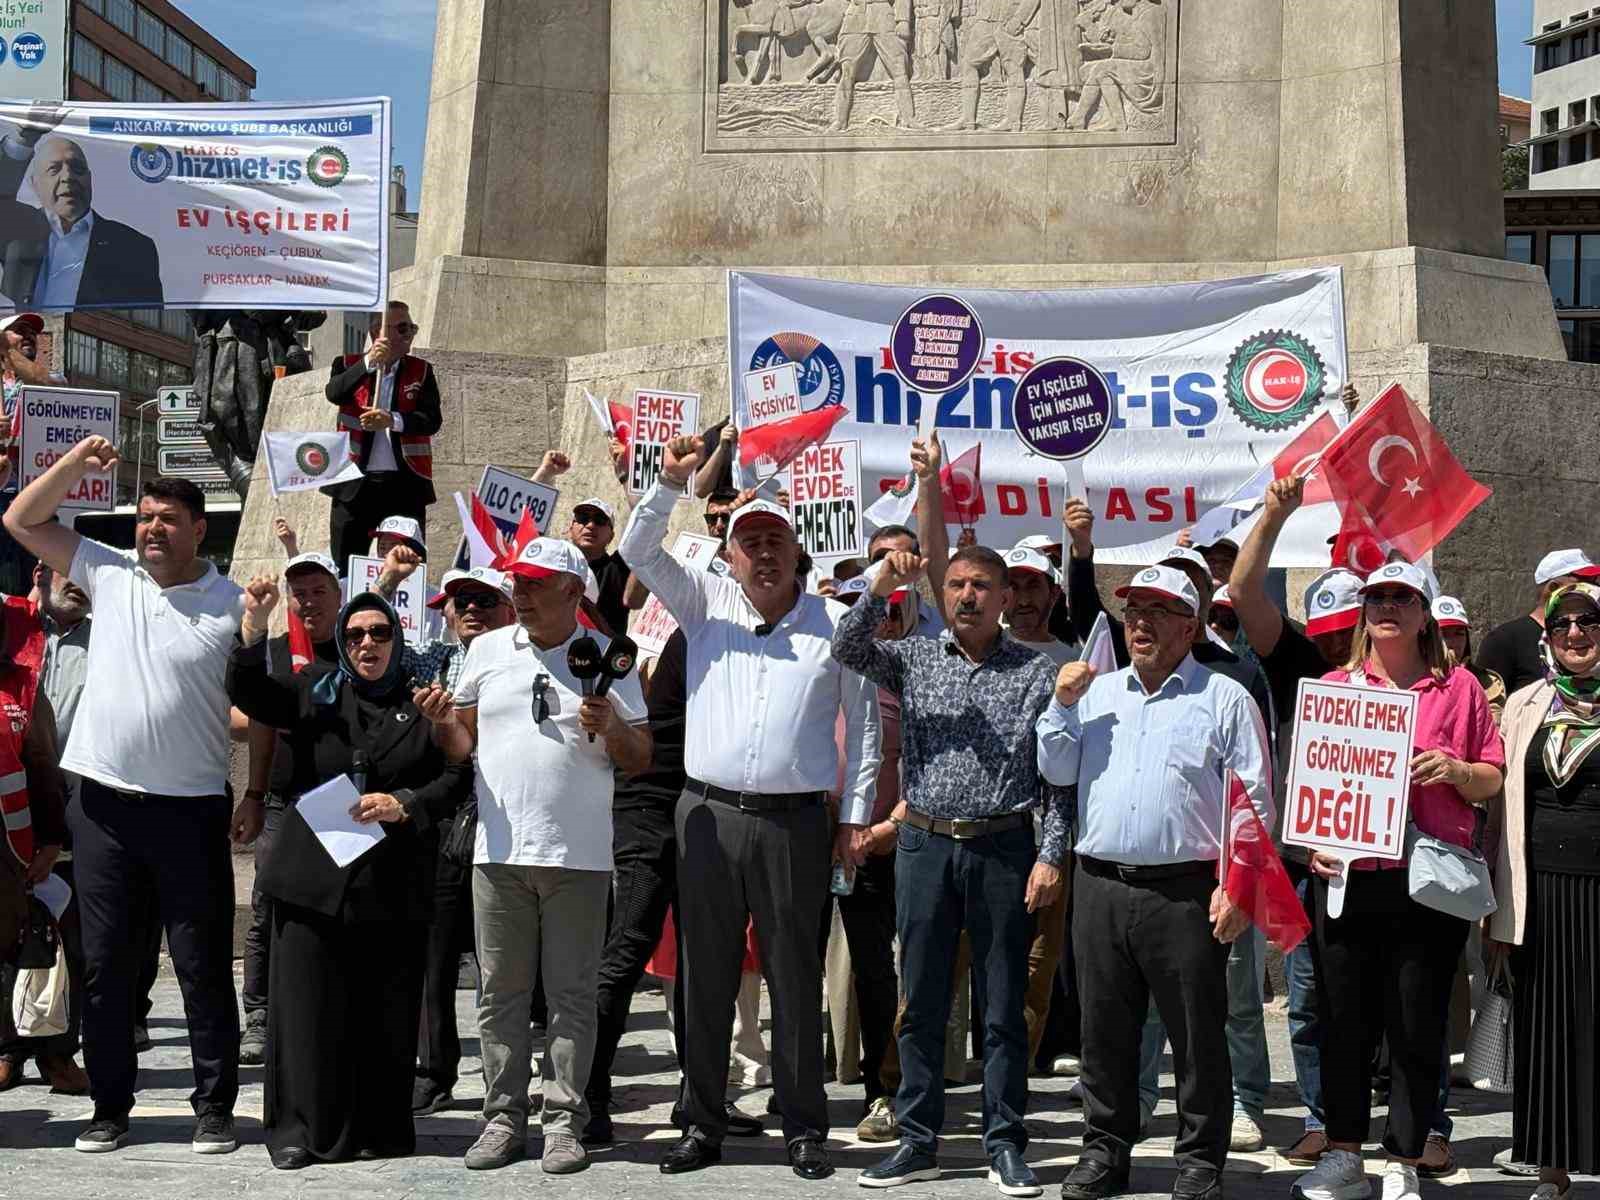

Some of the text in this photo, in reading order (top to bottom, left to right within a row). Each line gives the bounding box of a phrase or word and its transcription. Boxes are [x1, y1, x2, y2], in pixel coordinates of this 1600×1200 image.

[0, 16, 25, 28] lun!
[20, 51, 36, 60] Yok
[112, 120, 172, 132] ANKARA
[230, 122, 265, 135] ŞUBE
[269, 118, 352, 135] BAŞKANLIĞI
[177, 206, 350, 235] EV İŞÇİLERİ
[207, 246, 266, 260] KEÇİÖREN
[279, 247, 322, 260] ÇUBUK
[203, 274, 272, 286] PURSAKLAR
[285, 275, 330, 287] MAMAK
[763, 374, 776, 391] EV
[1027, 370, 1088, 399] EV İŞÇİLERİ
[26, 399, 112, 422] GÖRÜNMEYEN
[638, 396, 684, 421] EMEK
[1029, 393, 1093, 422] İÇİN İNSANA
[1028, 412, 1103, 441] YAKIŞIR İŞLER
[794, 447, 844, 475] EMEK
[794, 499, 857, 554] EMEKTİR
[686, 542, 702, 559] EV
[1303, 694, 1409, 733] EVDEKİ EMEK
[1306, 735, 1397, 779] GÖRÜNMEZ
[1295, 778, 1377, 844] DEĞİL
